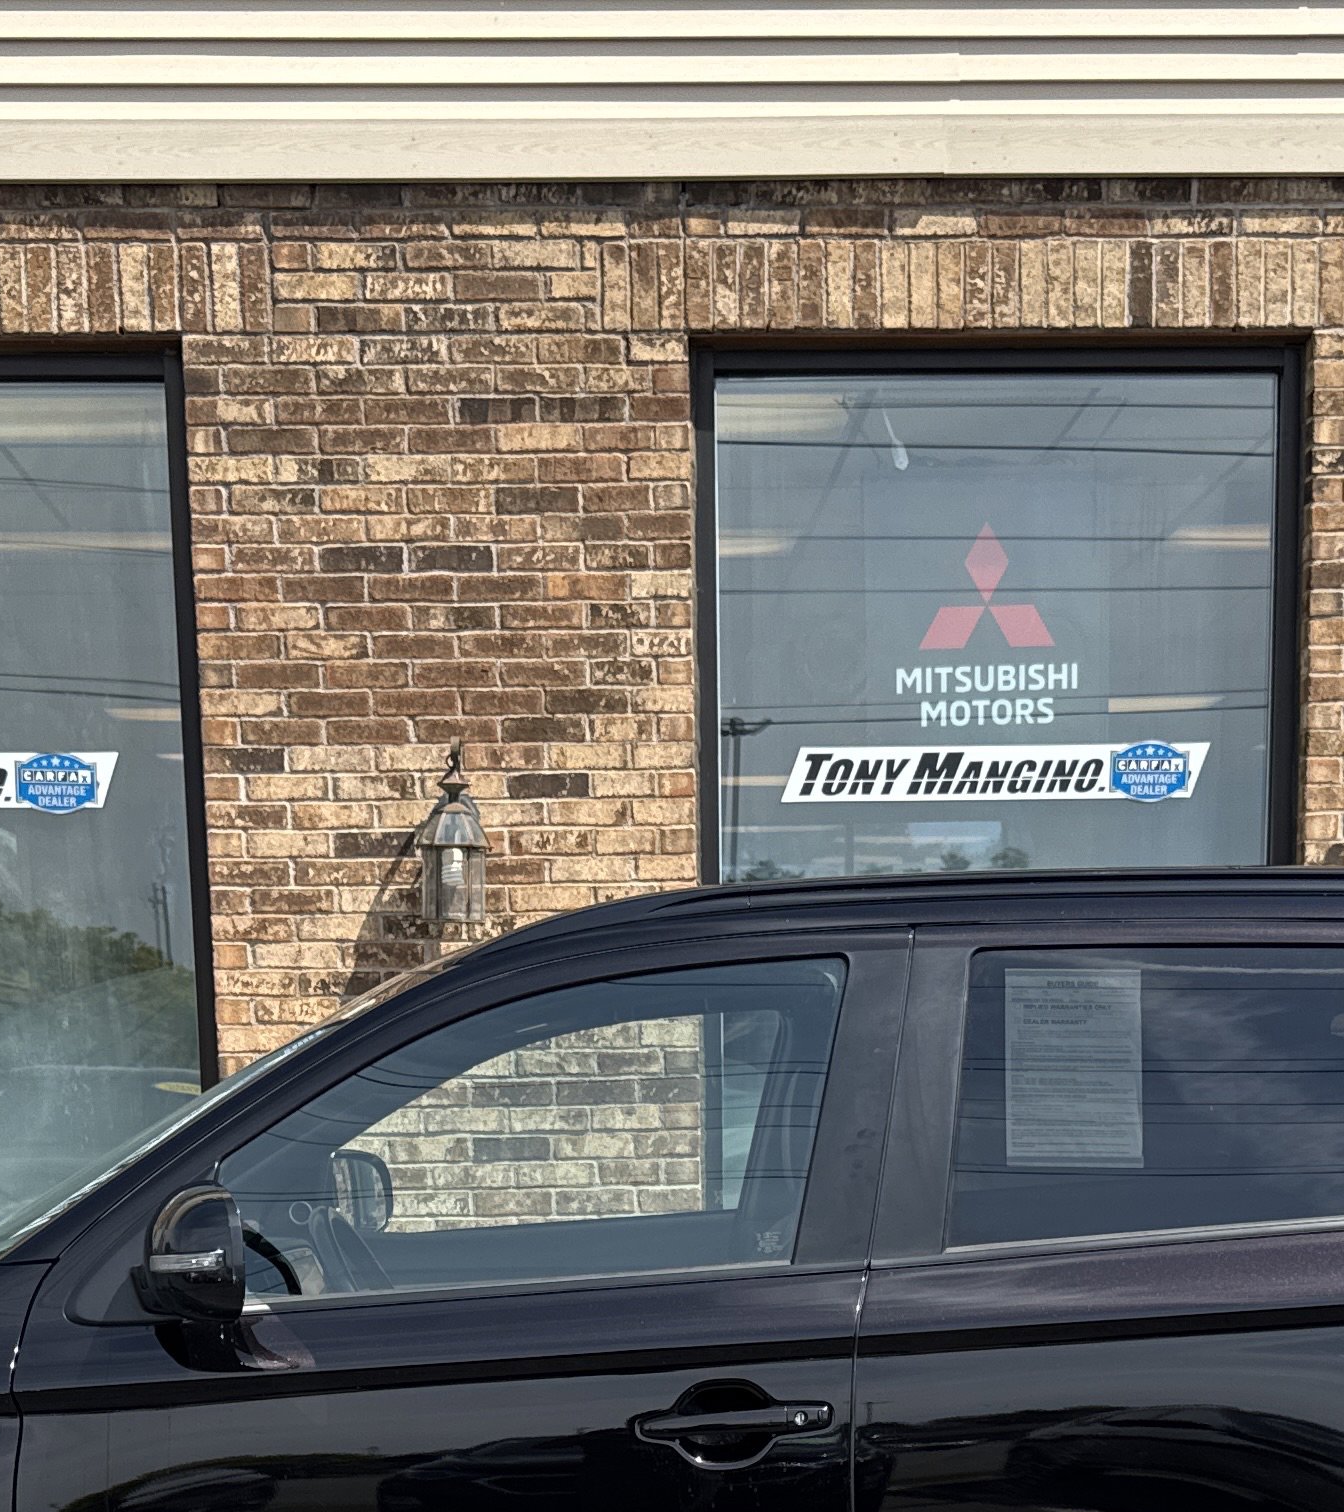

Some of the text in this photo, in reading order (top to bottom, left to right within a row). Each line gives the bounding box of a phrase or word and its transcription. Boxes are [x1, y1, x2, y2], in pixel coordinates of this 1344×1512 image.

[895, 663, 1078, 695] MITSUBISHI
[920, 697, 1055, 728] MOTORS
[1116, 758, 1184, 773] CARFAX
[22, 769, 94, 785] CARFAX
[1120, 772, 1178, 786] ADVANTAGE
[27, 785, 88, 797] ADVANTAGE
[1130, 784, 1168, 797] DEALER
[38, 796, 77, 808] DEALER
